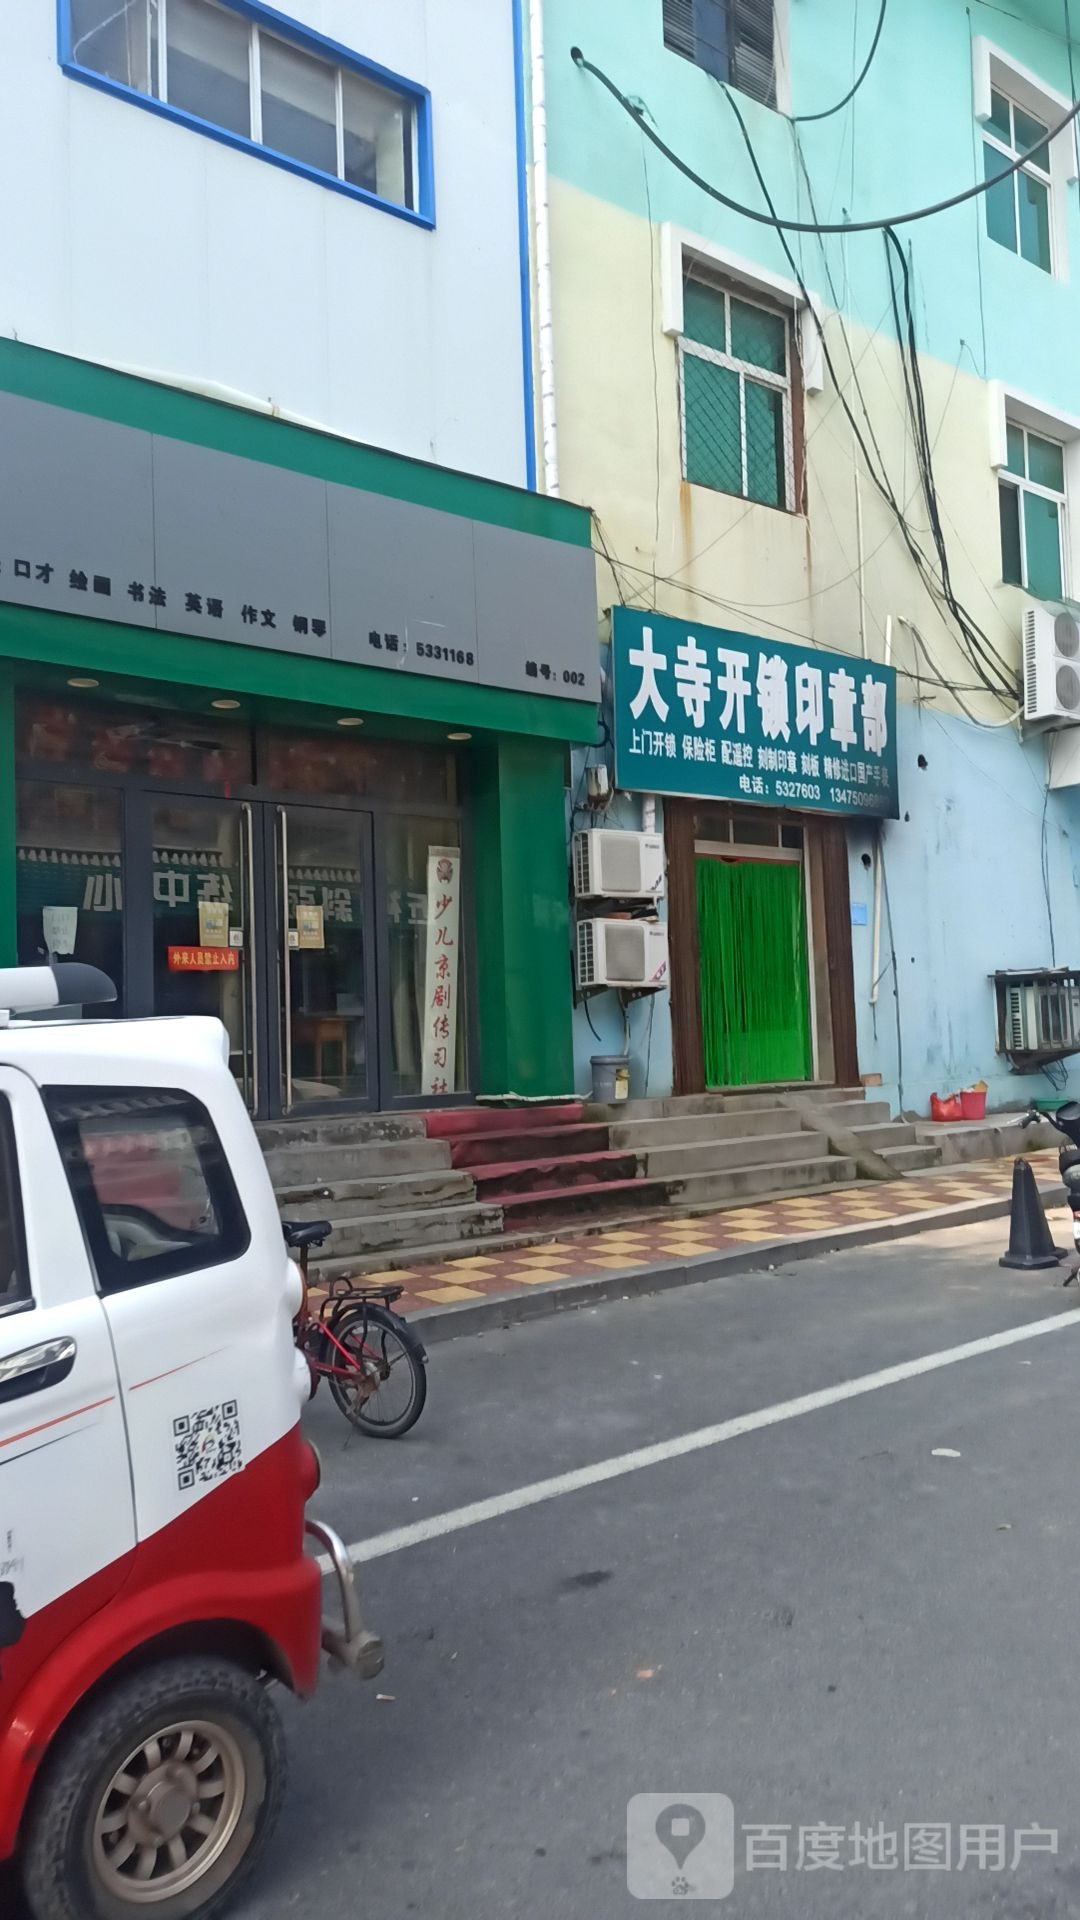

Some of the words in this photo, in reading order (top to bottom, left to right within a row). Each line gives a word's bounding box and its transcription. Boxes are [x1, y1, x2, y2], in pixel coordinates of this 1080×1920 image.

[13, 558, 54, 584] 口才
[127, 581, 167, 607] 书法
[185, 592, 223, 619] 英语
[240, 604, 277, 629] 作文
[292, 614, 327, 637] 钢琴
[628, 625, 888, 757] 大寺开锁印章部
[629, 729, 676, 758] 上门开锁
[681, 733, 717, 763] 保险柜
[720, 739, 753, 769] 配遥控
[757, 744, 798, 775] 刻制印章
[801, 750, 820, 777] 刻板
